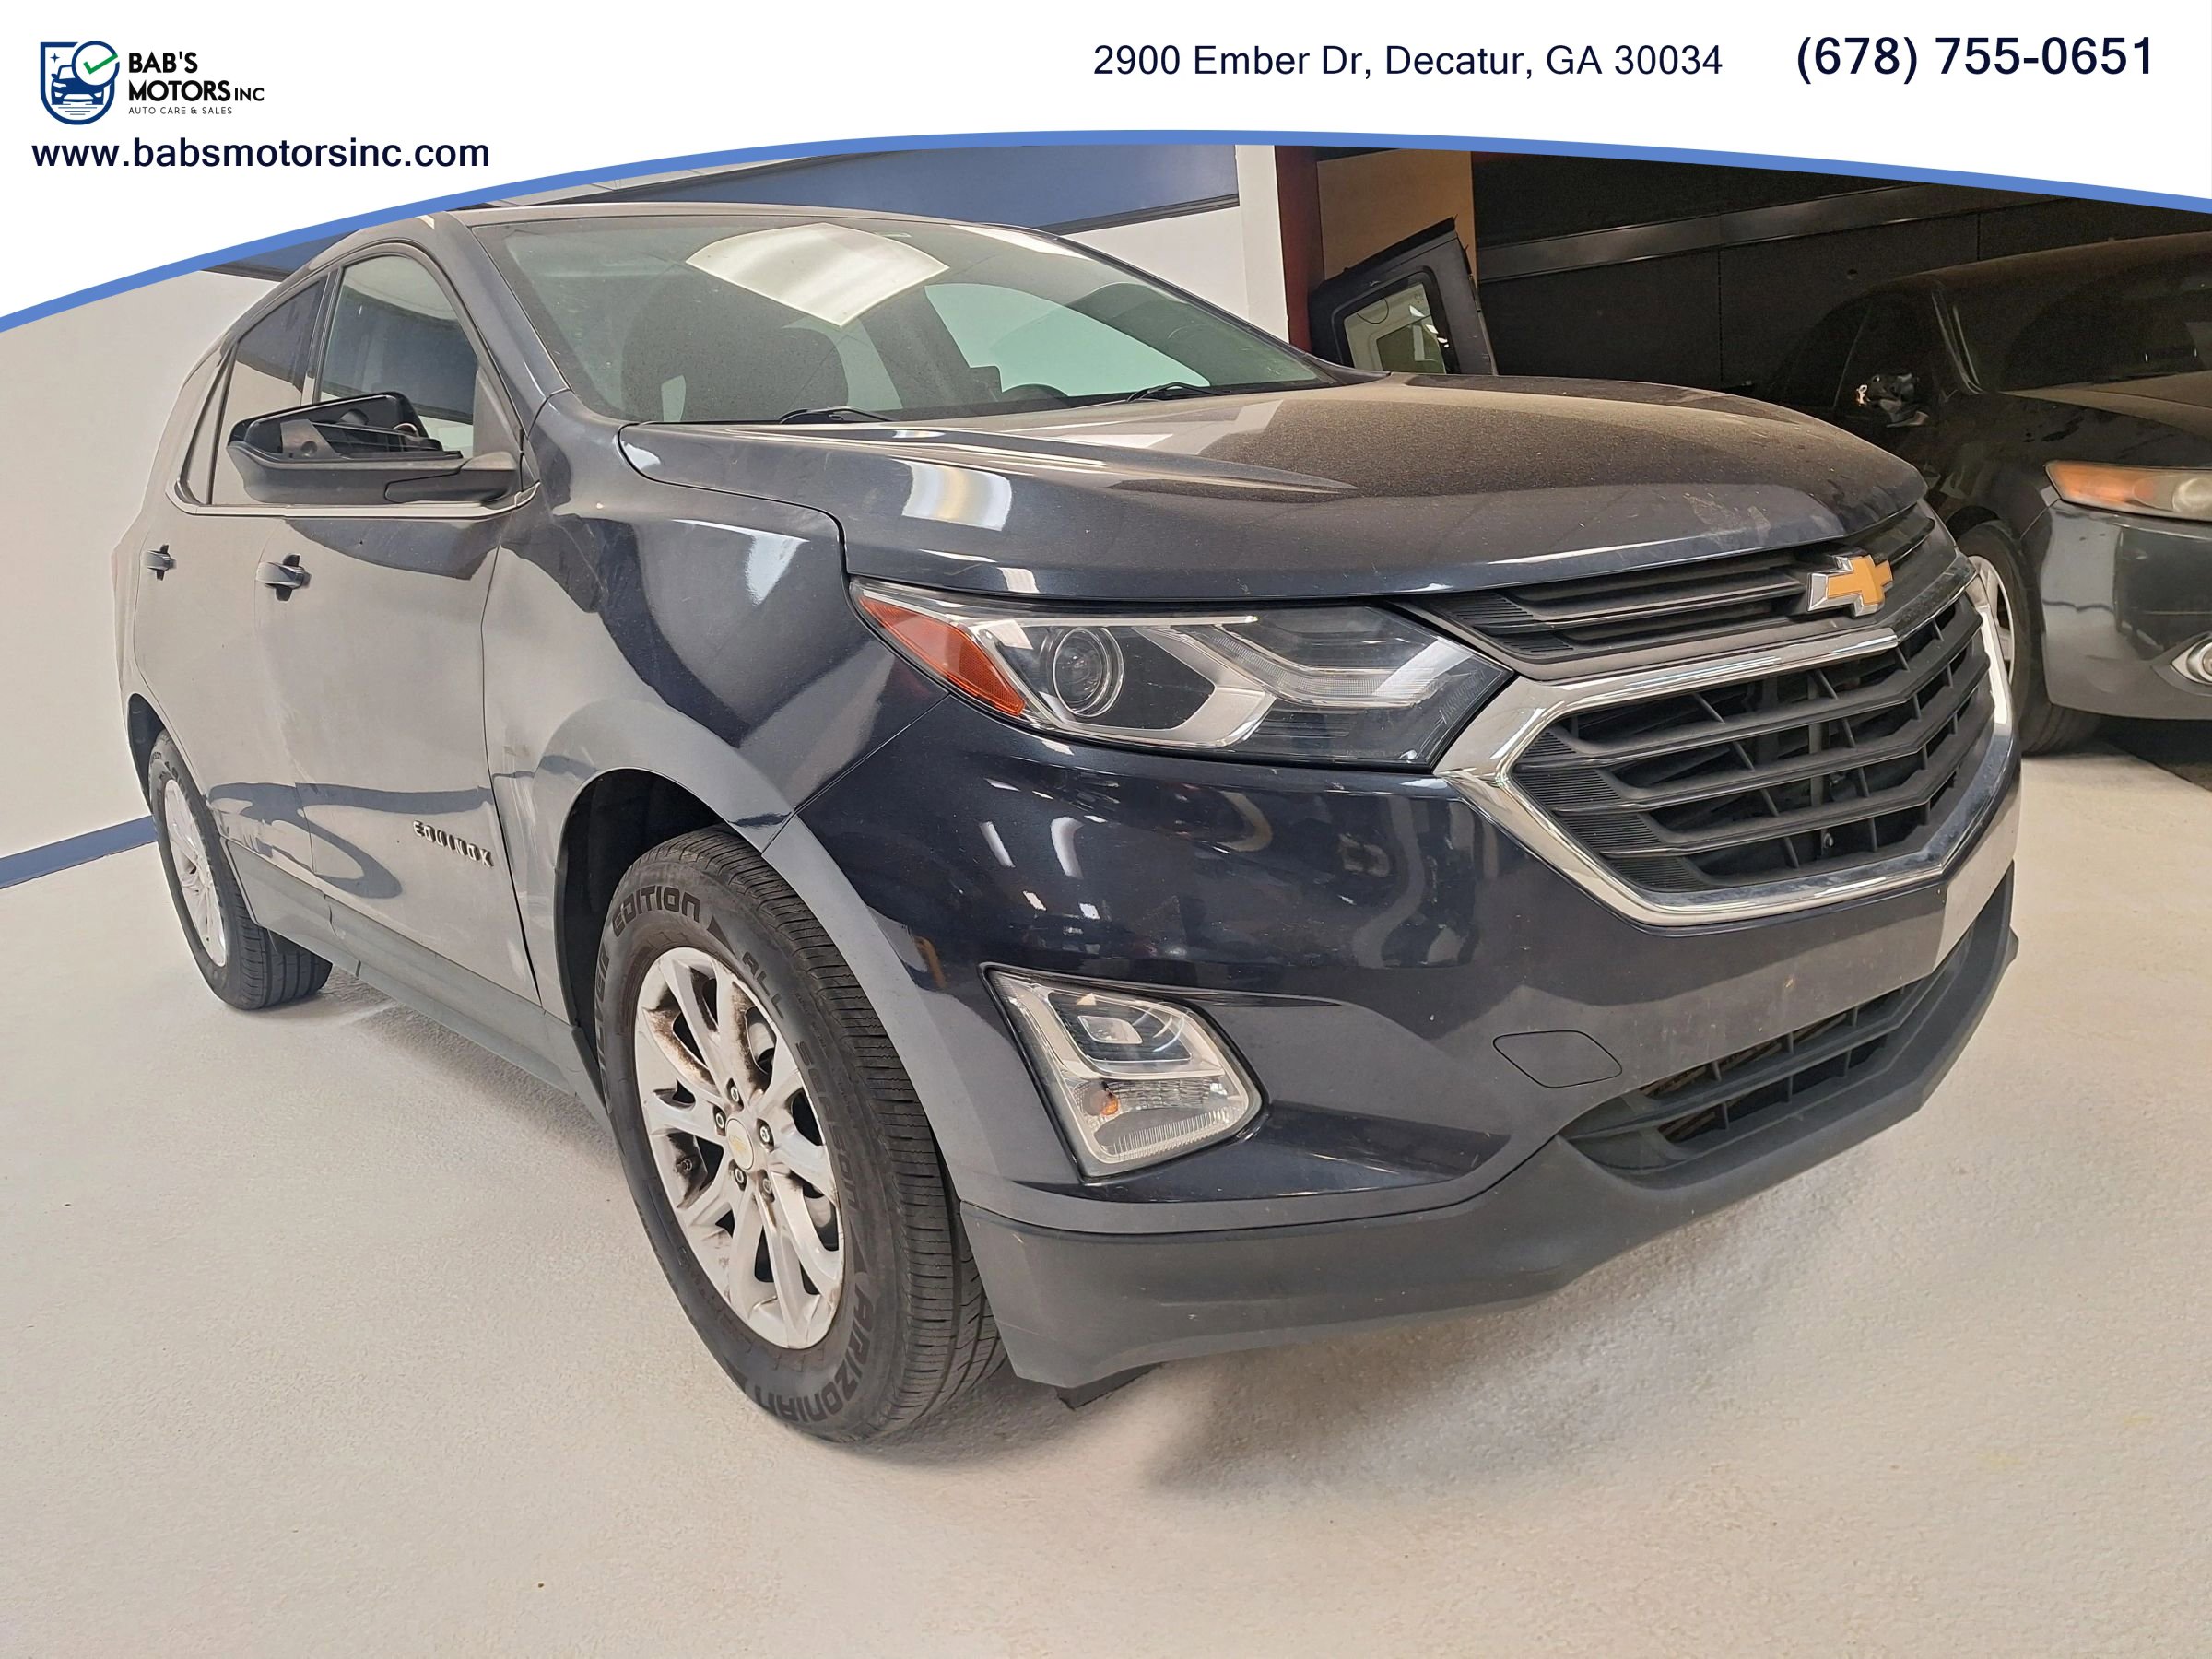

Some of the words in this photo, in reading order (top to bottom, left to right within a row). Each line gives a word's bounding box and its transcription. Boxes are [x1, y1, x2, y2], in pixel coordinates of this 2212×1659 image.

[413, 819, 495, 868] EQUINOX
[612, 886, 701, 938] EDITION
[742, 951, 783, 1019] ALL
[753, 1283, 873, 1422] ARIZONIAN
